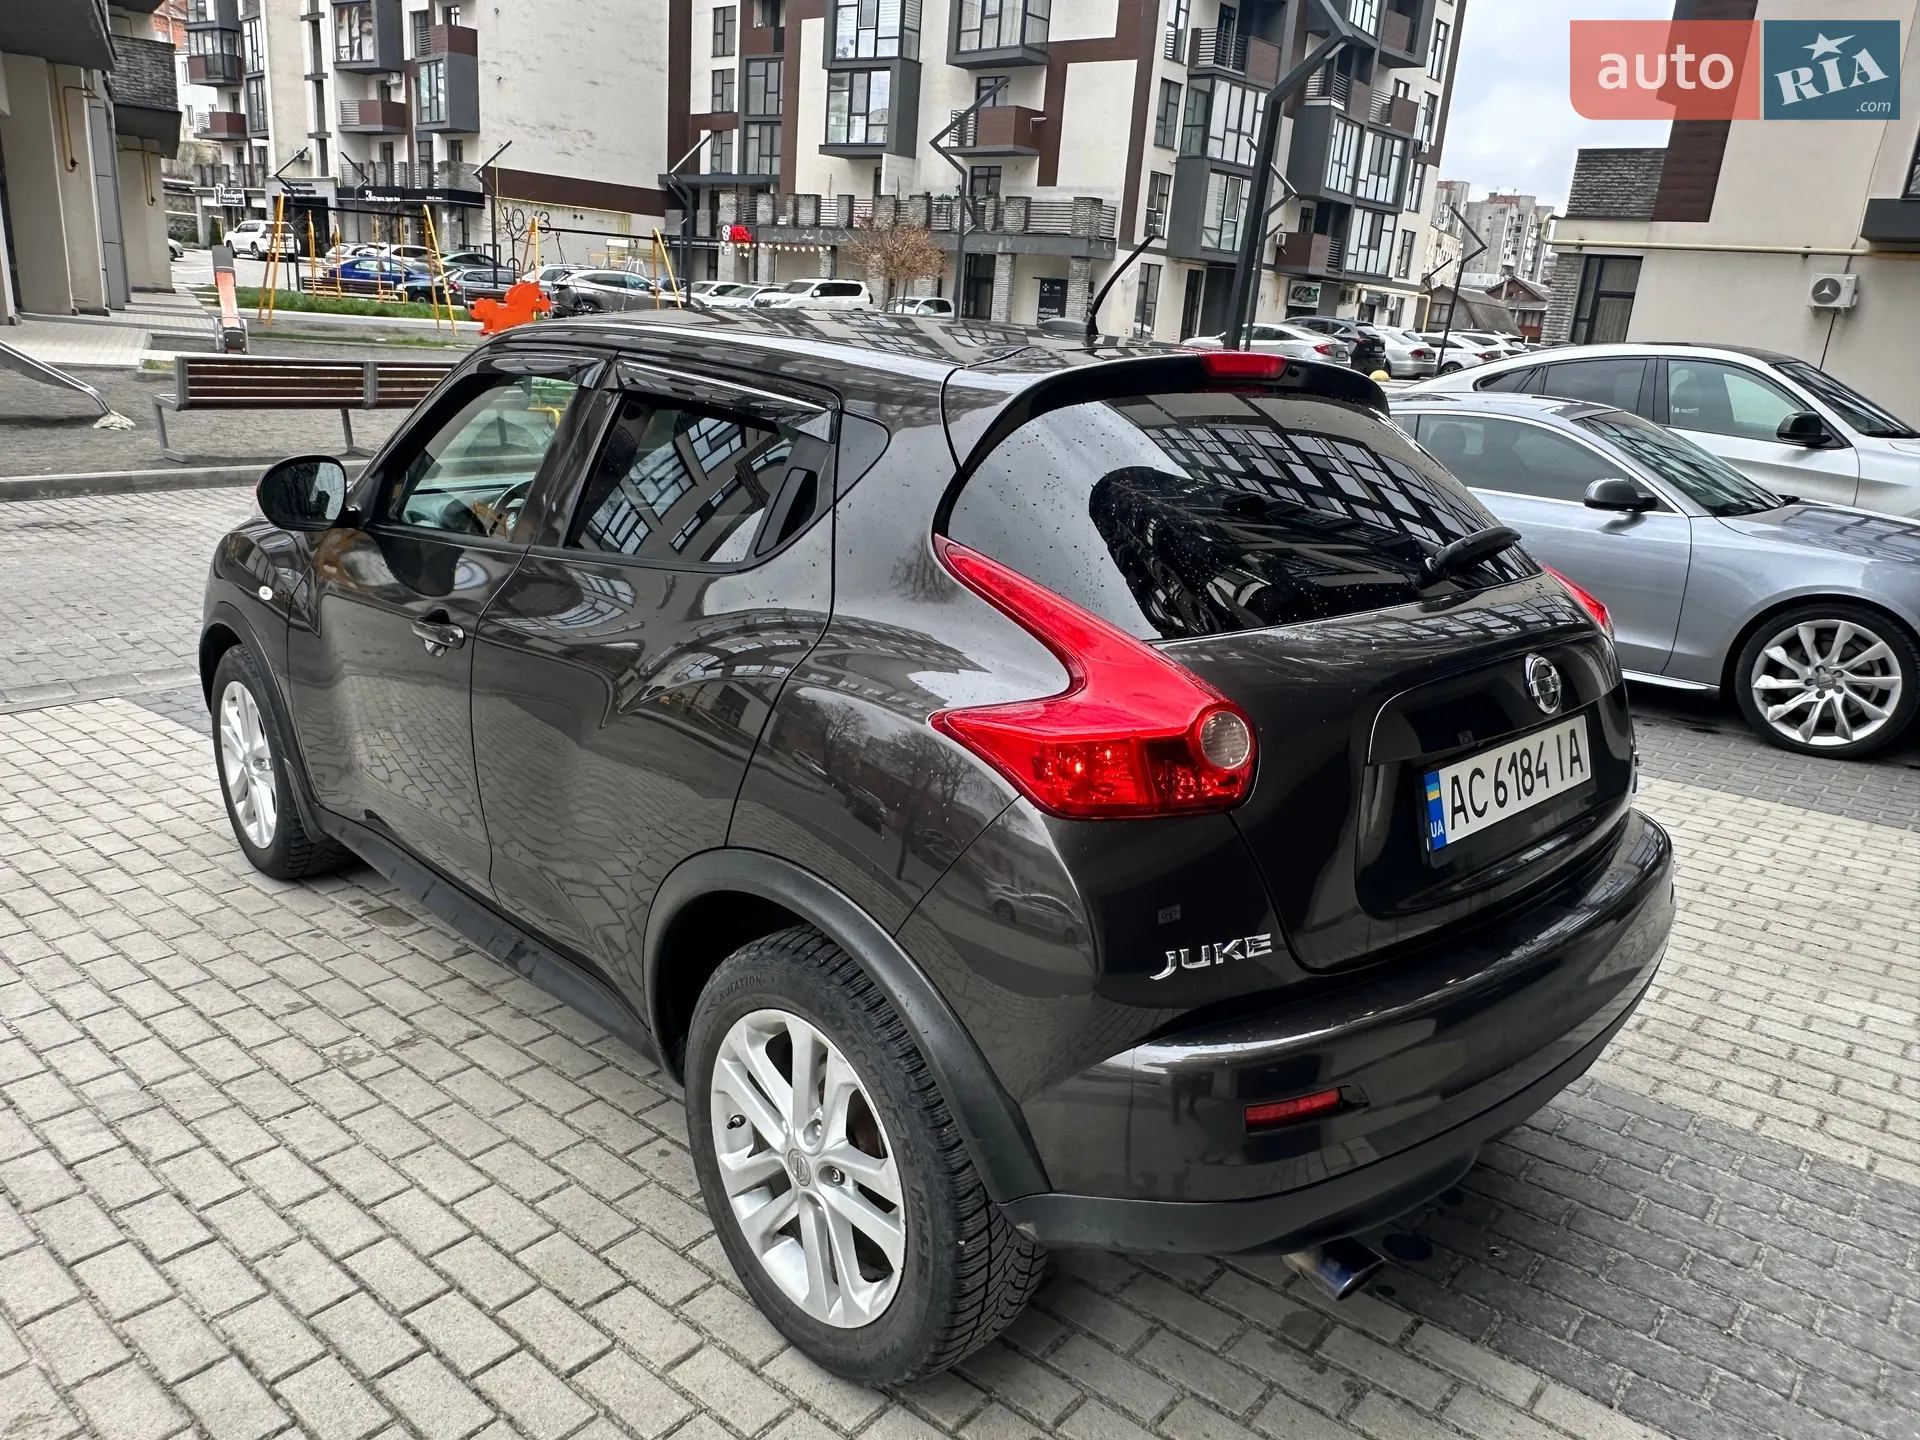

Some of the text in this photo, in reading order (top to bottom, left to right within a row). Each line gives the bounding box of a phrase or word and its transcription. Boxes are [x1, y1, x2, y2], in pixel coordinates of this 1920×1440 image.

[503, 206, 552, 234] 103
[1450, 728, 1584, 831] AC 6184 IA
[1430, 820, 1445, 837] UA
[1149, 932, 1273, 981] JUKE
[718, 975, 762, 1002] ROTATION
